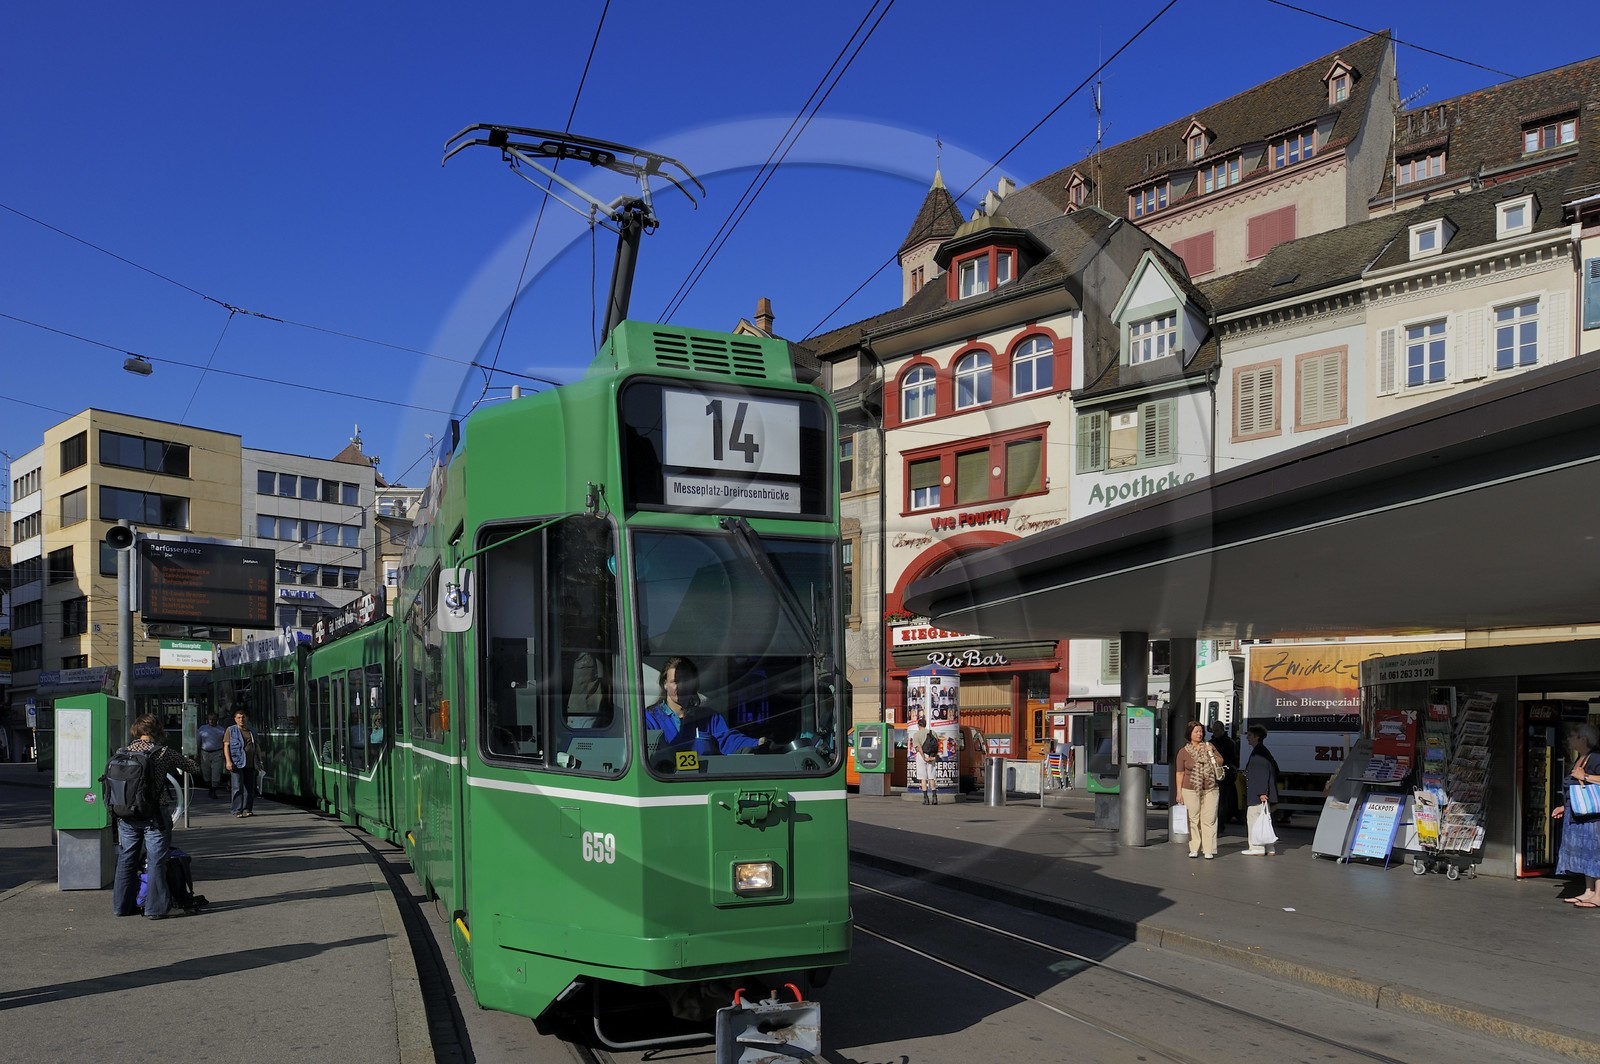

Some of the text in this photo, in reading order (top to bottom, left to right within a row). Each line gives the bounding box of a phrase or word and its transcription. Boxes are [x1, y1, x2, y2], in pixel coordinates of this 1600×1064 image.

[705, 399, 760, 464] 14
[673, 482, 790, 501] Messeplatz-Dreirosenbrücke
[1087, 470, 1195, 508] Apotheke
[930, 507, 1011, 532] Vve Fourny
[150, 544, 202, 555] Barfüsserplatz
[93, 624, 101, 632] 15
[926, 649, 1008, 668] Rio Bar
[1379, 667, 1434, 681] Tel. 061 263 31 20
[1275, 697, 1298, 707] Eine
[1275, 713, 1292, 723] der
[1294, 713, 1336, 723] Brauerei
[678, 754, 697, 768] 23
[1367, 804, 1395, 812] JACKPOTS
[582, 831, 616, 865] 659
